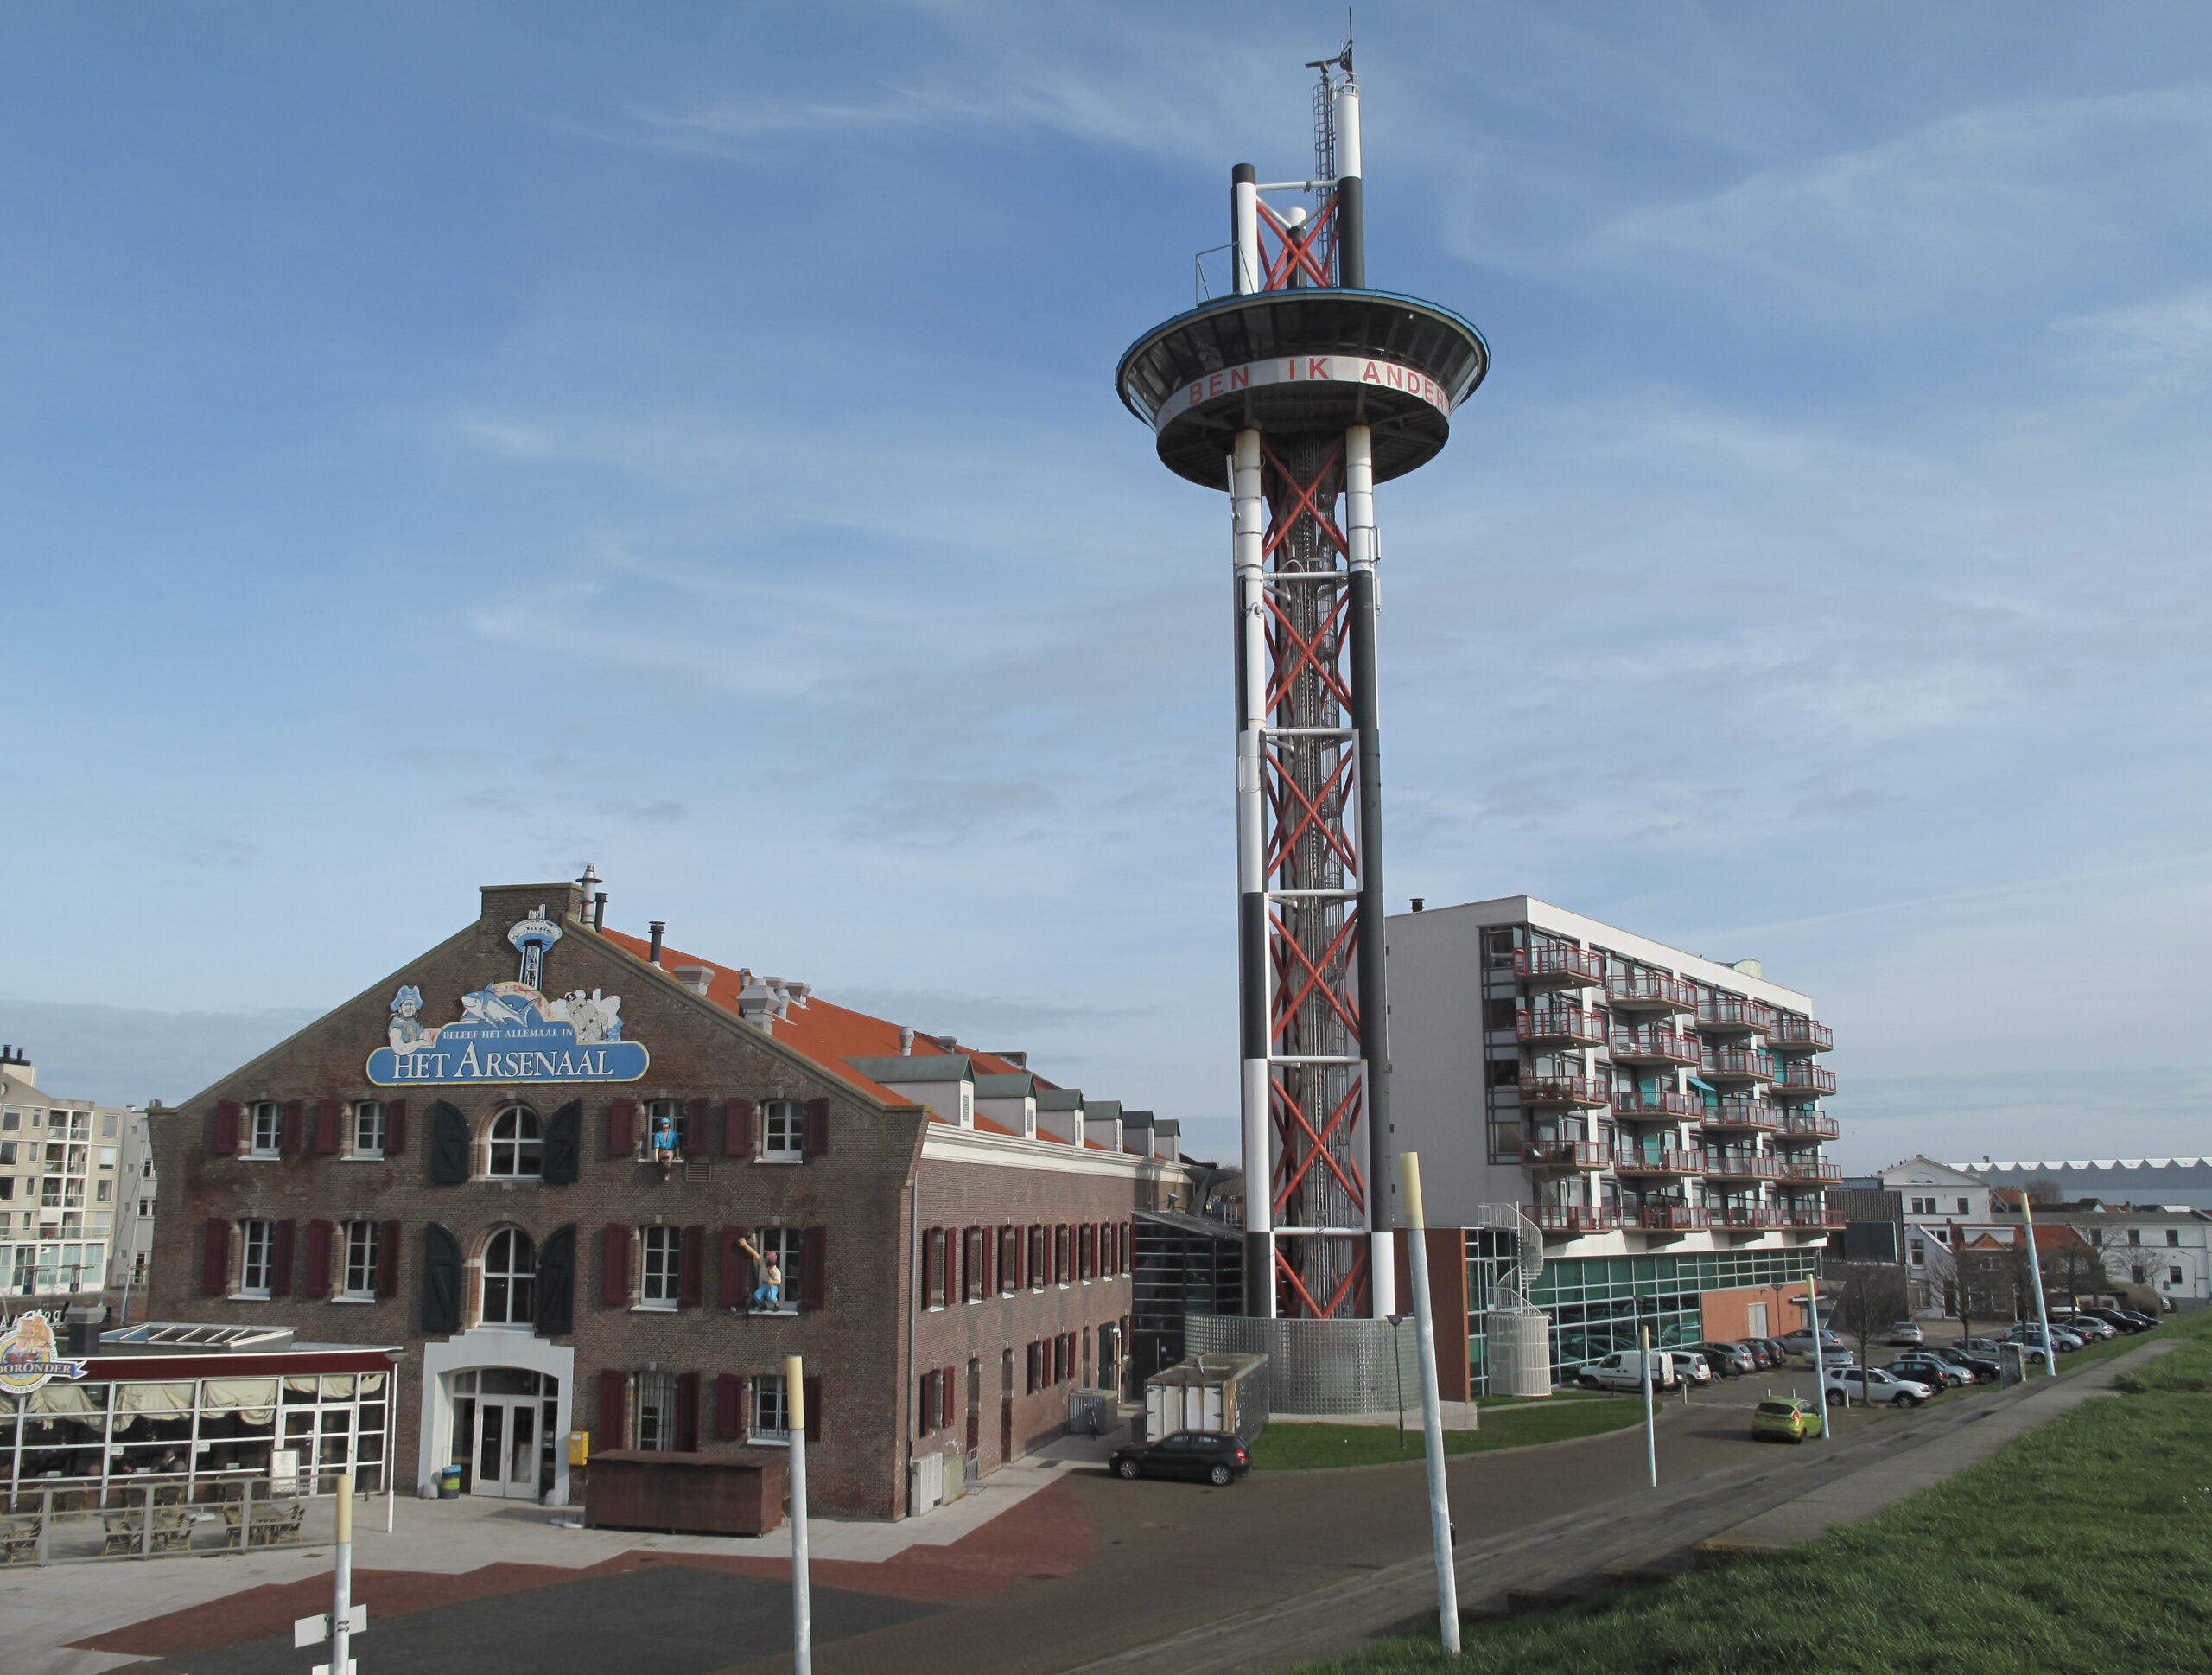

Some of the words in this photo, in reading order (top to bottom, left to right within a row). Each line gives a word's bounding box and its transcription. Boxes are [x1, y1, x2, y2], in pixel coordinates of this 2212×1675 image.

[1189, 365, 1250, 405] BEN
[1289, 357, 1329, 380] IK
[1362, 361, 1450, 413] ANDER
[442, 1030, 479, 1039] BELEEF
[481, 1029, 502, 1038] HET
[505, 1029, 558, 1037] ALLEMAAL
[561, 1028, 573, 1036] IN
[391, 1053, 451, 1079] HET
[453, 1041, 614, 1078] ARSENAAL
